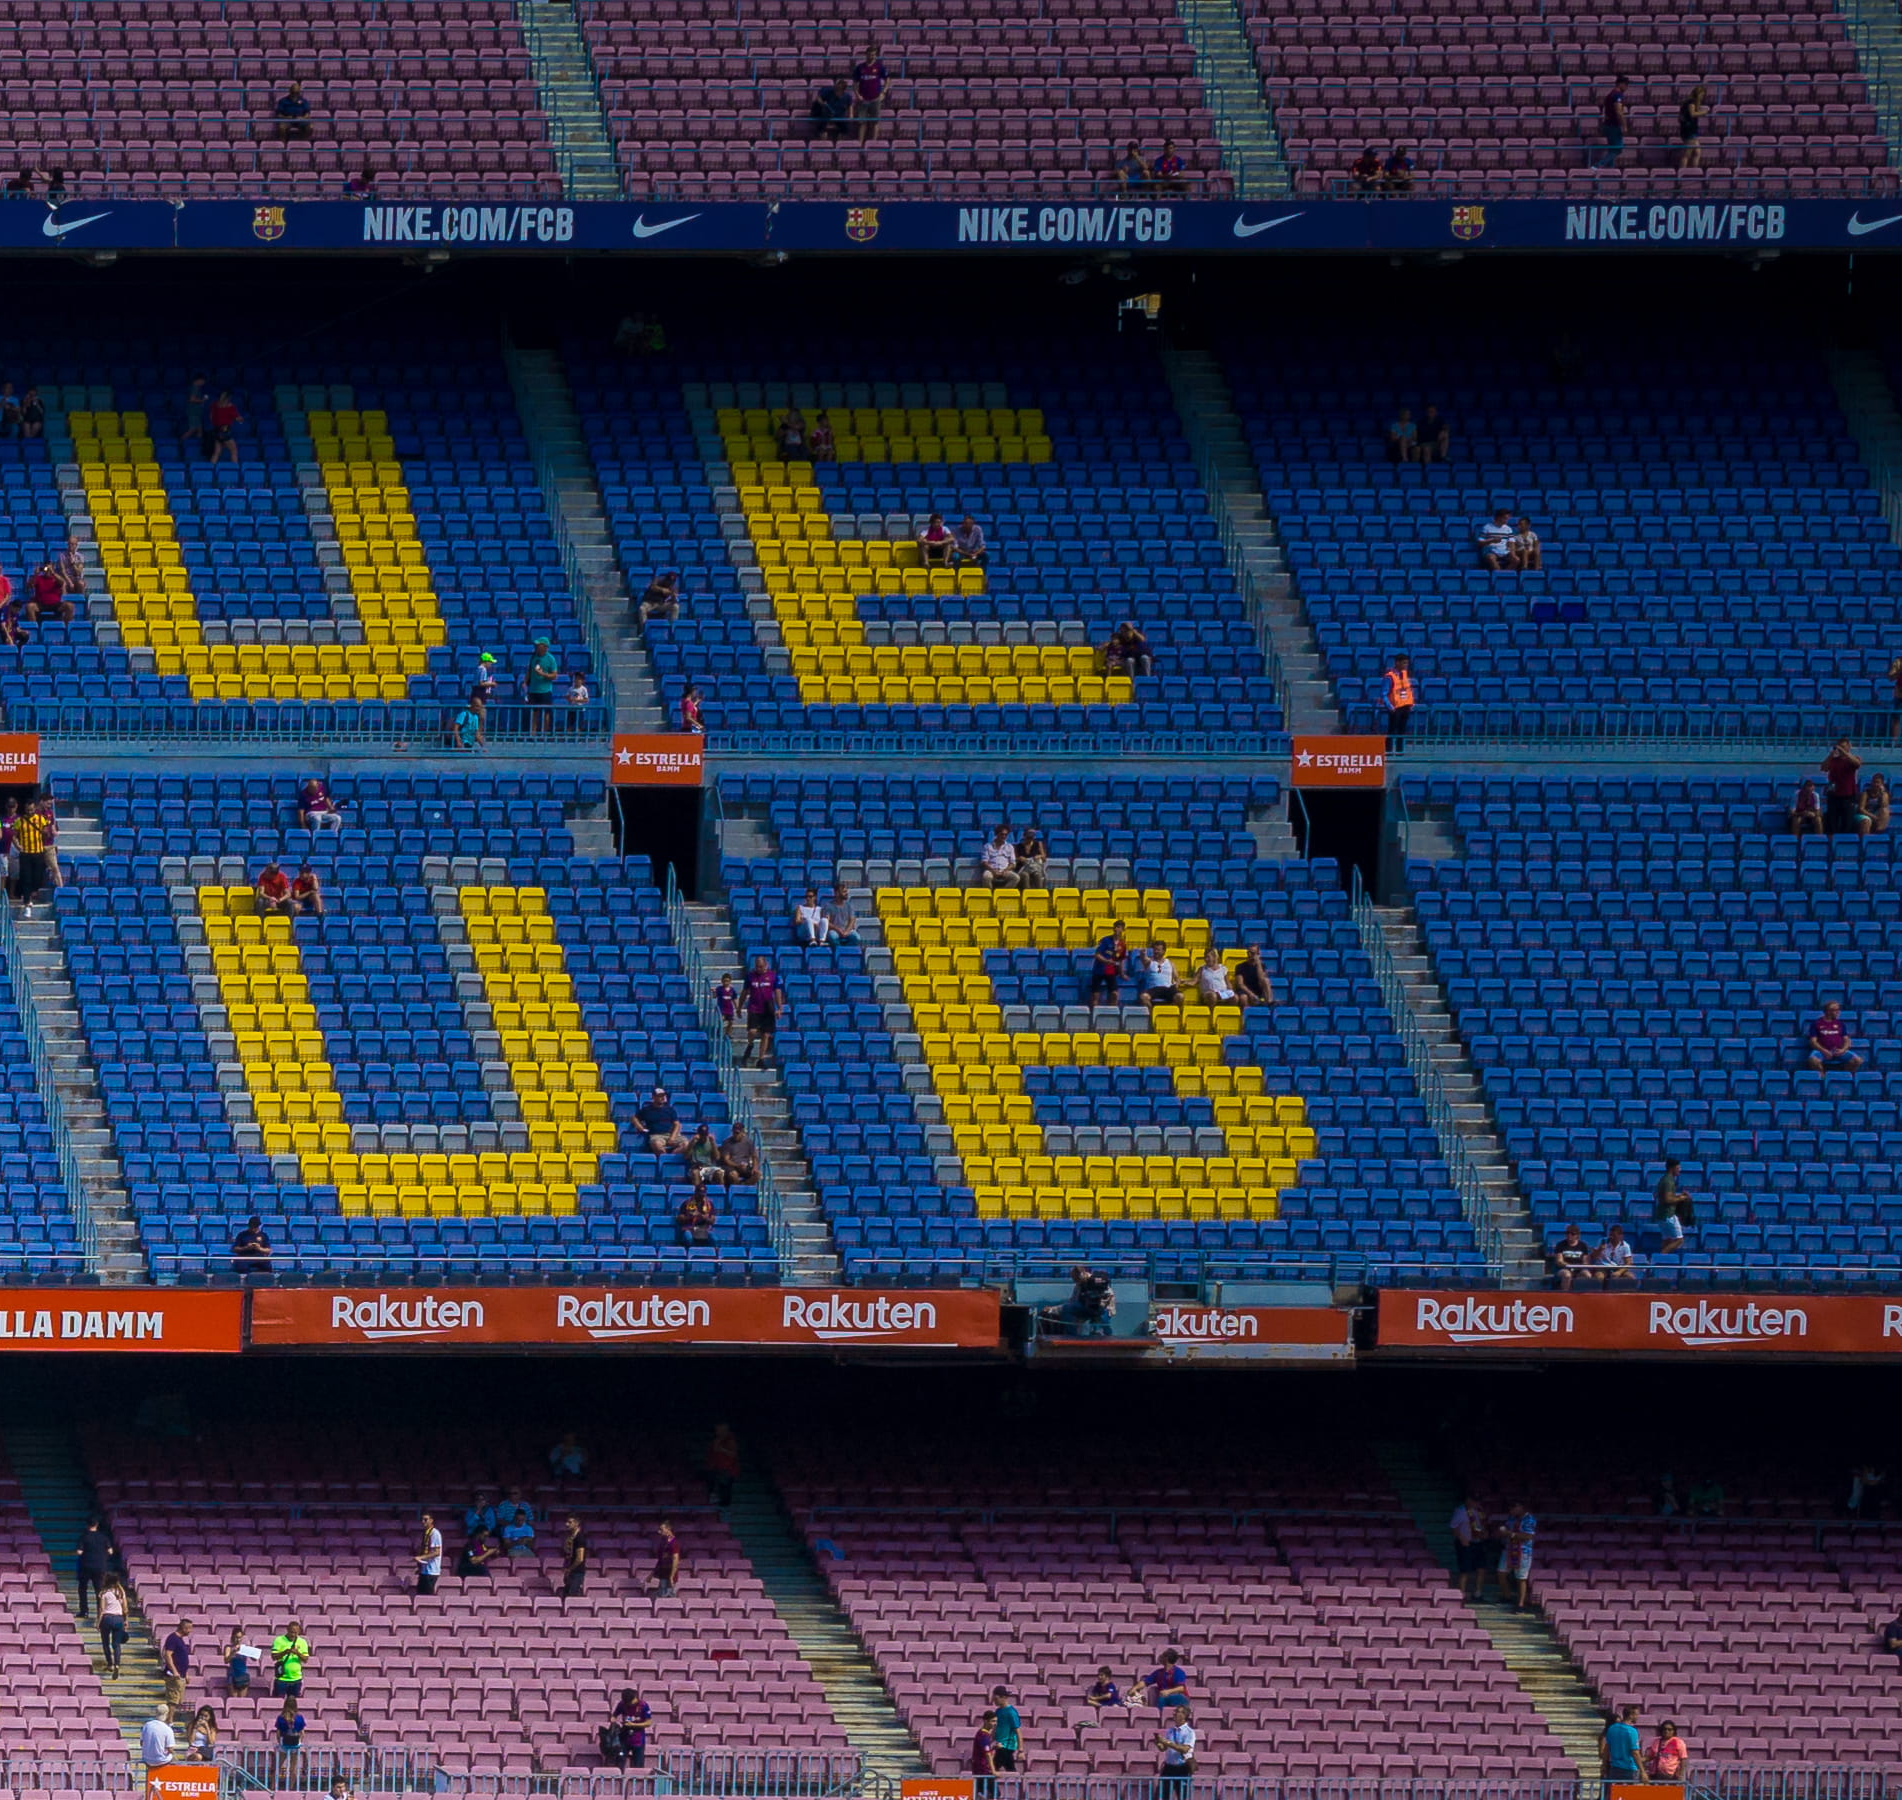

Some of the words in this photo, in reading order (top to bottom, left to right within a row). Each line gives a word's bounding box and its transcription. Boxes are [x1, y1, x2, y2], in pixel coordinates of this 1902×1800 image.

[363, 204, 575, 241] NIKE.COM/FCB
[958, 205, 1174, 241] NIKE.COM/FCB
[1566, 205, 1785, 241] NIKE.COM/FCB
[635, 752, 701, 766] ESTRELLA
[1316, 754, 1383, 767] ESTRELLA
[61, 1311, 163, 1339] DAMM
[332, 1293, 484, 1328] Rakuten
[557, 1292, 710, 1327] Rakuten
[782, 1294, 936, 1329] Rakuten
[1156, 1308, 1258, 1336] akuten
[1417, 1297, 1574, 1332] Rakuten
[1649, 1300, 1807, 1335] Rakuten
[165, 1781, 217, 1792] ESTRELLA
